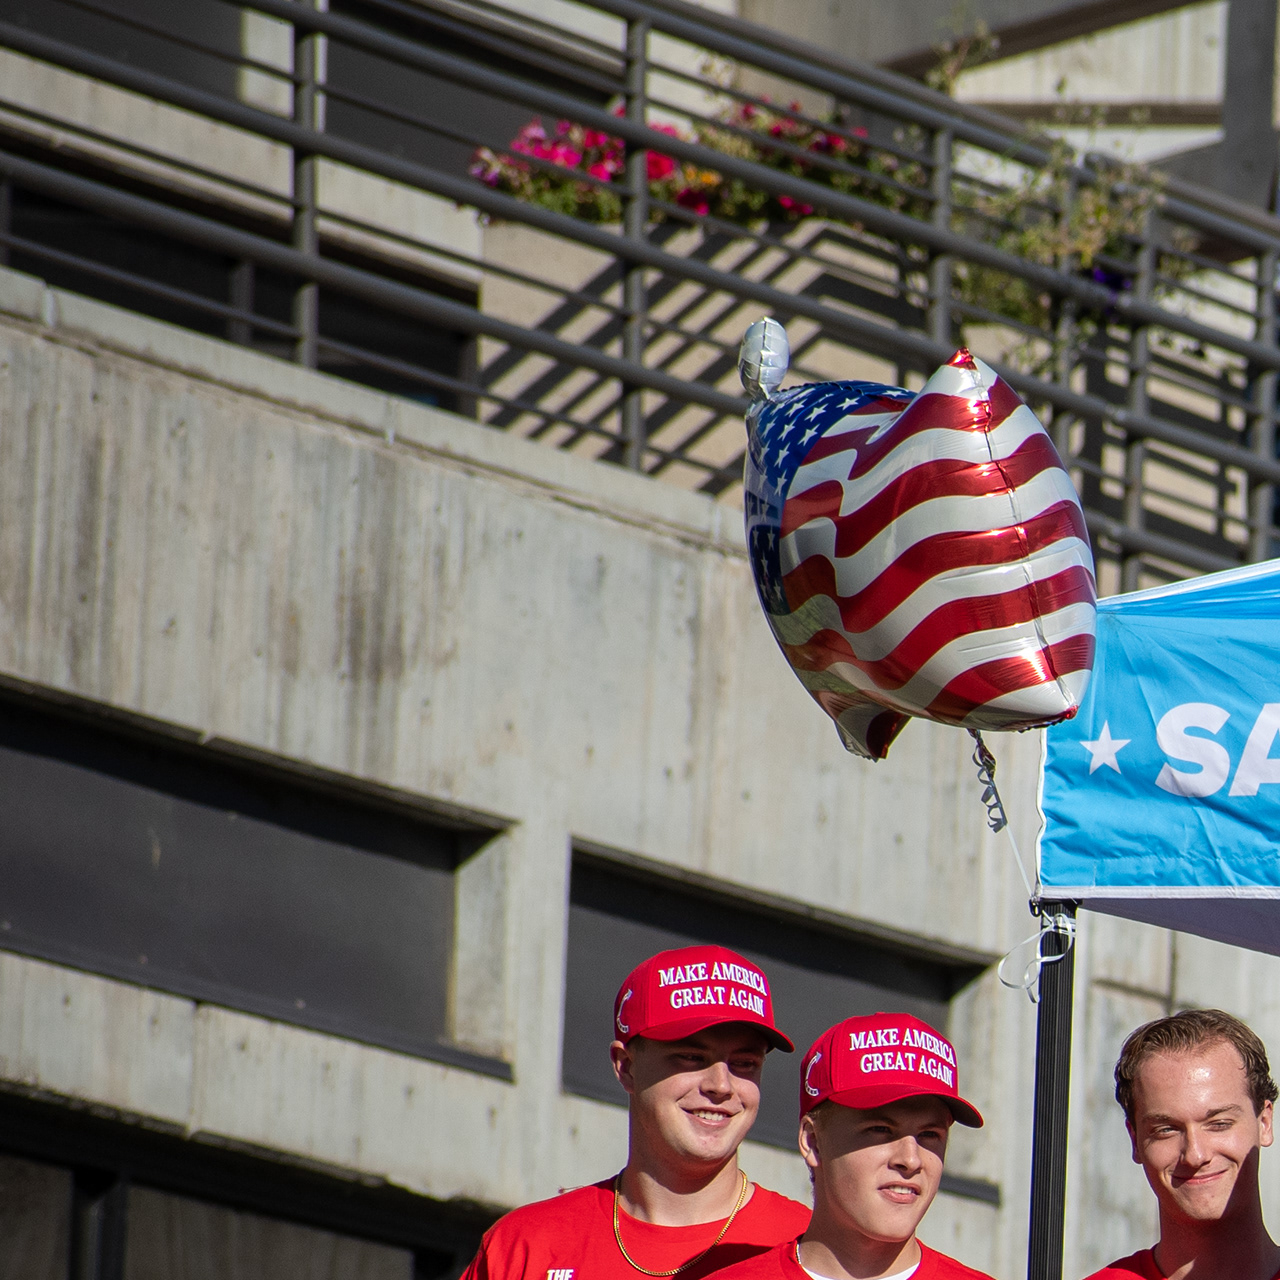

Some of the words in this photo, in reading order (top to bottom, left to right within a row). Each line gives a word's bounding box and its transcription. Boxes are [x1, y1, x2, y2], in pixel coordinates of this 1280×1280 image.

[658, 962, 708, 988] MAKE
[710, 961, 767, 996] AMERICA
[670, 986, 725, 1009] GREAT
[728, 987, 765, 1018] AGAIN
[849, 1028, 899, 1051] MAKE
[901, 1028, 956, 1067] AMERICA
[860, 1051, 916, 1073] GREAT
[918, 1055, 953, 1088] AGAIN
